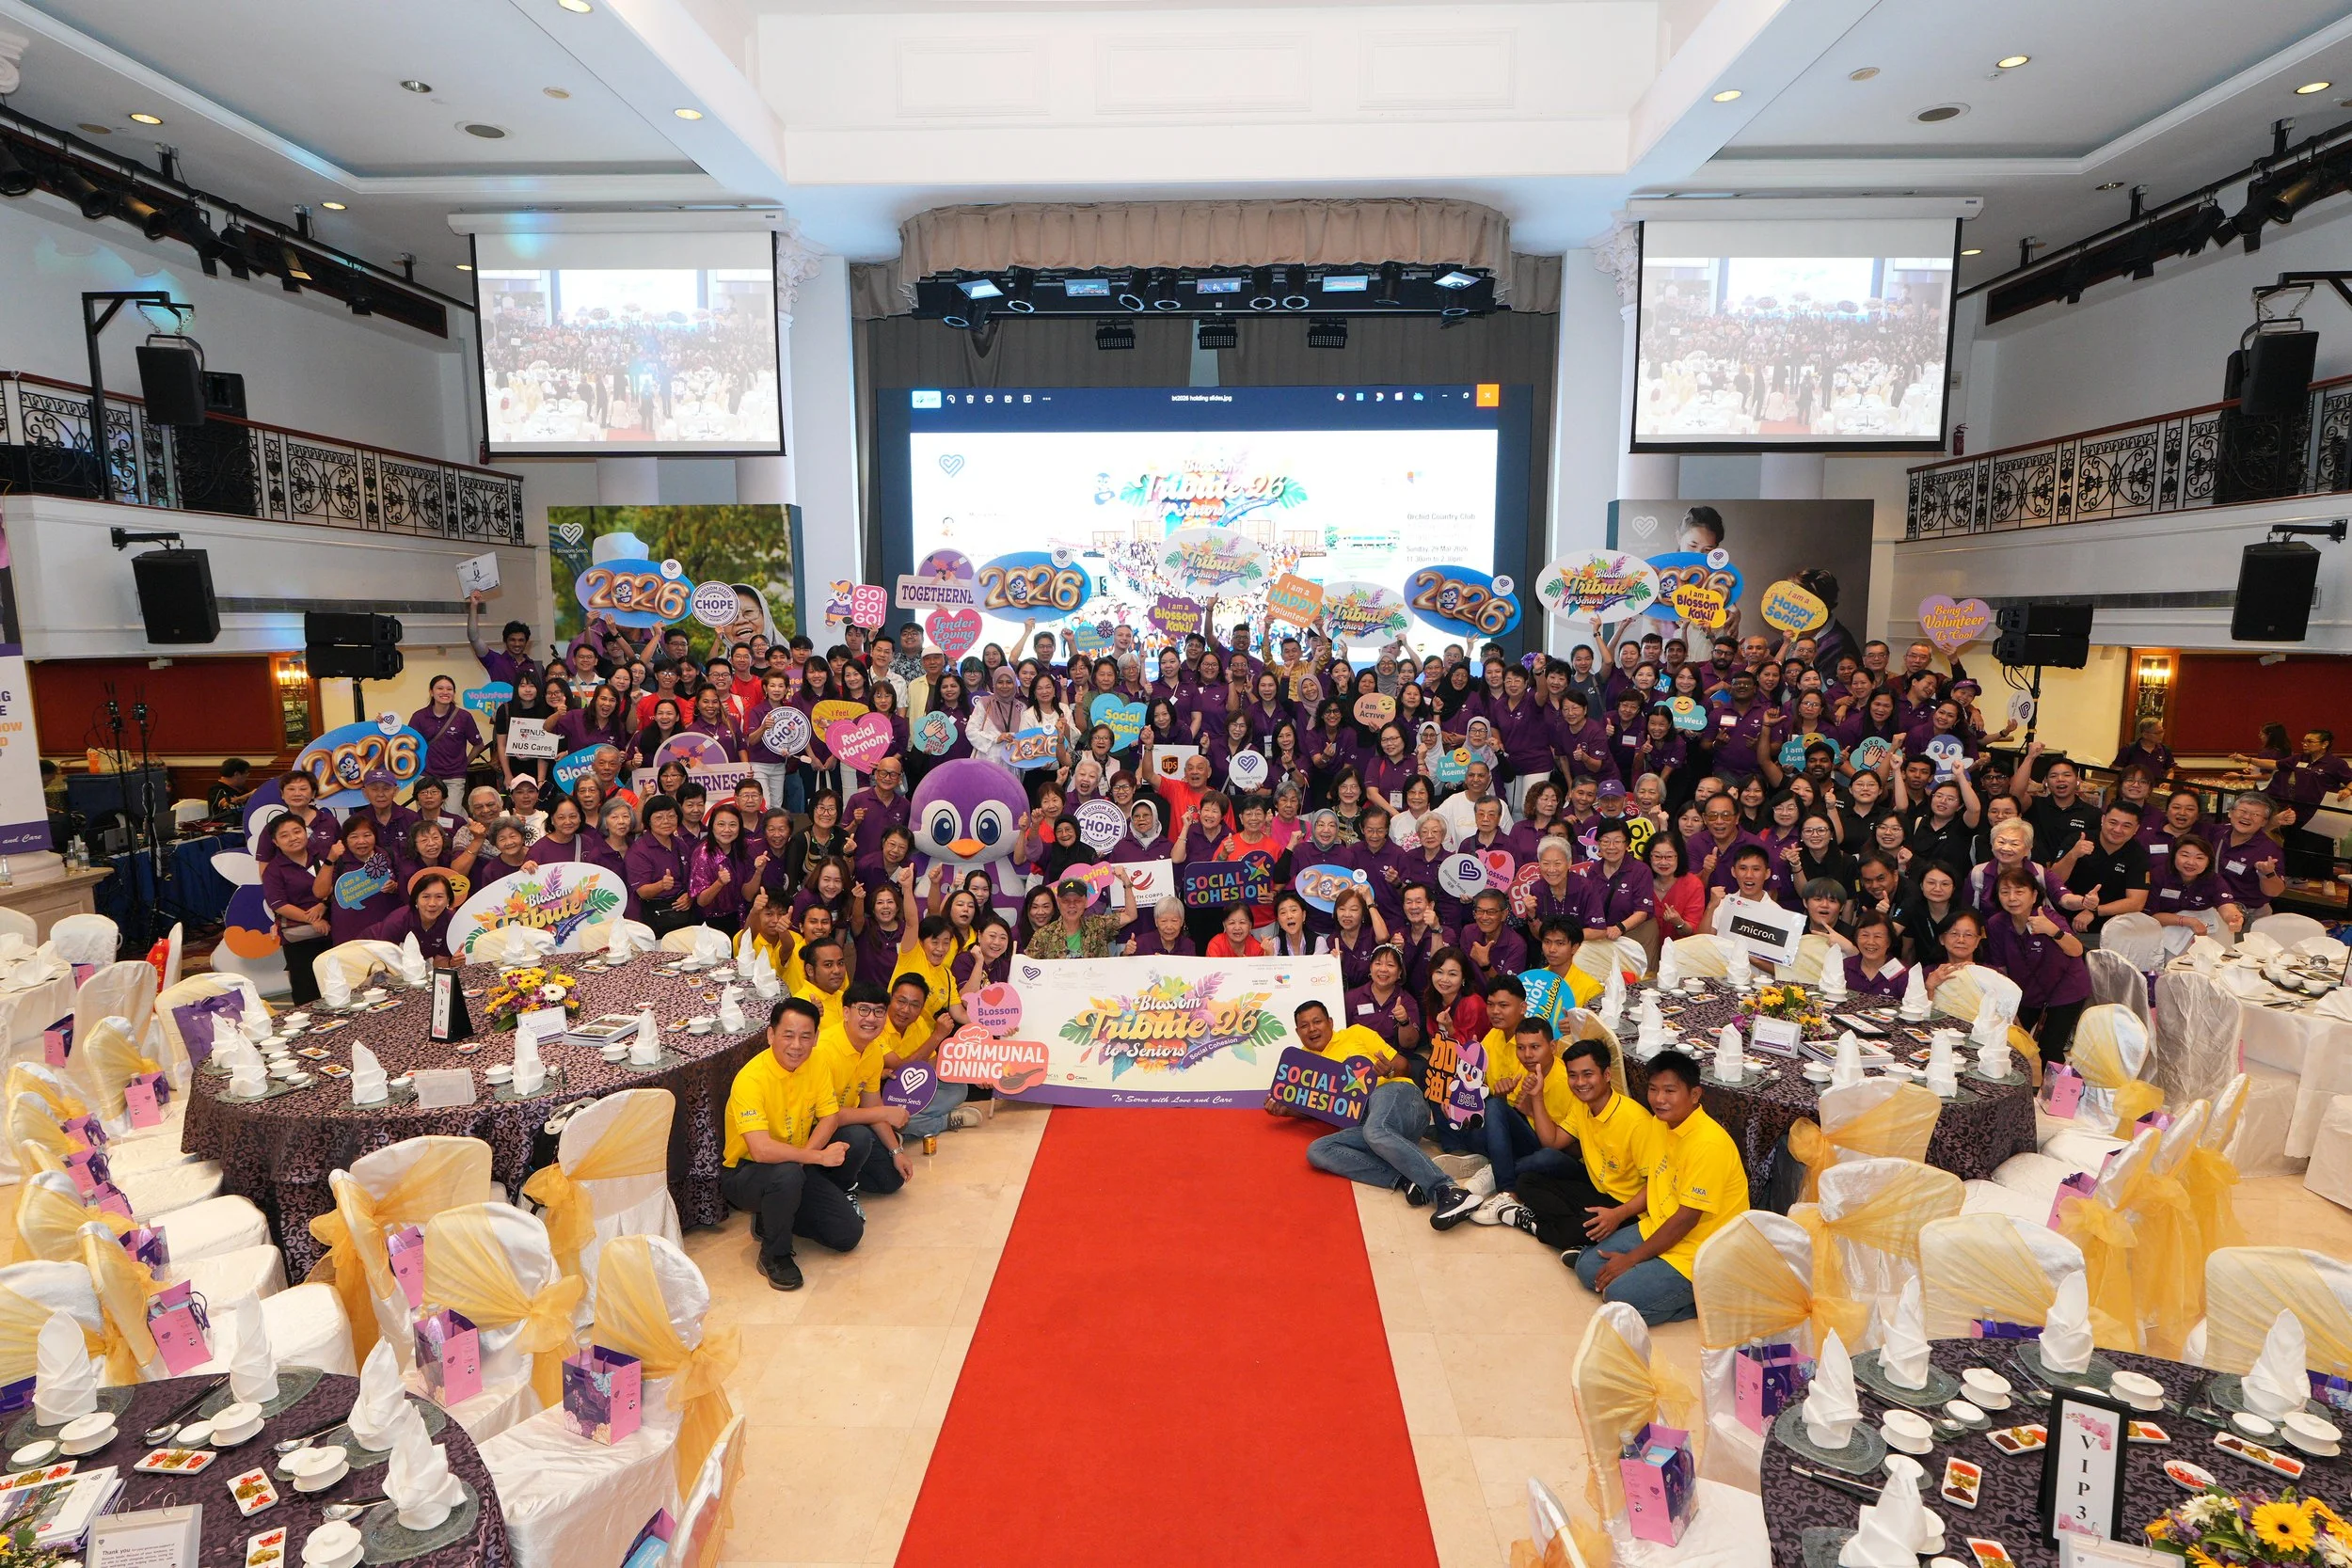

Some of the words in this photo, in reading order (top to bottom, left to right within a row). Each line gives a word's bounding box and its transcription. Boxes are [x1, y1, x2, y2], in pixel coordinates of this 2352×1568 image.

[1212, 546, 1241, 557] Blossom
[1186, 551, 1244, 571] Tribute
[1194, 569, 1218, 579] Seniors
[1595, 568, 1627, 579] Blossom
[697, 586, 717, 599] BLOSSOM
[718, 586, 731, 598] SEEDS
[979, 565, 1083, 610] 2026
[1292, 585, 1303, 594] am
[1566, 577, 1629, 595] Tribute
[586, 568, 690, 620] 2026
[856, 588, 884, 601] GO!
[1565, 595, 1575, 605] to
[1576, 595, 1603, 605] Seniors
[1792, 593, 1804, 601] am
[695, 599, 734, 610] CHOPE
[855, 601, 882, 613] GO!
[1270, 589, 1317, 615] HAPPY
[1356, 598, 1385, 610] Blossom
[1412, 571, 1514, 635] 2026
[1677, 594, 1720, 610] Blossom
[1772, 594, 1816, 621] Happy
[1934, 605, 1961, 616] Being
[1963, 603, 1974, 613] A
[853, 612, 882, 626] GO!
[1154, 609, 1199, 622] Blossom
[1270, 604, 1310, 624] Volunteer
[1329, 603, 1386, 624] Tribute
[1687, 607, 1715, 622] Kaki!
[1765, 606, 1808, 629] Senior
[933, 617, 975, 631] Tender
[1166, 620, 1193, 633] Kaki!
[1339, 621, 1363, 631] Seniors
[1923, 614, 1984, 629] Volunteer
[932, 630, 975, 642] Loving
[1935, 631, 1947, 641] Is
[1948, 629, 1974, 641] Cool
[937, 640, 969, 651] Care
[1105, 708, 1140, 723] Social
[530, 728, 545, 736] NUS
[770, 715, 803, 748] CHOPE
[841, 723, 876, 746] Racial
[838, 732, 890, 761] Harmony
[927, 738, 945, 749] HIGH
[1006, 735, 1058, 763] 2026
[301, 735, 419, 800] 2026
[1163, 760, 1177, 772] ups
[1082, 804, 1106, 816] BLOSSOM
[1107, 806, 1120, 823] SEEDS
[1079, 817, 1120, 837] CHOPE
[1629, 821, 1651, 840] O!
[22, 833, 42, 843] Care
[1186, 871, 1244, 892] SOCIAL
[523, 886, 572, 908] Blossom
[1187, 882, 1270, 906] COHESION
[568, 912, 588, 927] Cohesion
[1739, 925, 1776, 941] micron
[977, 997, 980, 1006] I
[1134, 995, 1201, 1011] Blossom
[1076, 1008, 1205, 1040] Tribute
[1211, 1009, 1257, 1036] 26
[943, 1042, 1045, 1064] COMMUNAL
[1104, 1043, 1120, 1057] to
[1126, 1042, 1184, 1058] Seniors
[1189, 1045, 1207, 1060] Social
[1208, 1037, 1238, 1052] Cohesion
[941, 1060, 1003, 1079] DINING
[1277, 1064, 1338, 1094] SOCIAL
[887, 1095, 907, 1104] Blossom
[907, 1097, 922, 1106] Seeds
[1112, 1094, 1122, 1103] To
[1125, 1095, 1149, 1104] Serve
[1152, 1095, 1168, 1104] with
[1171, 1095, 1192, 1104] Love
[1194, 1096, 1210, 1104] and
[1213, 1096, 1232, 1104] Care
[1273, 1082, 1361, 1120] COHESION
[1457, 1092, 1477, 1107] BSL
